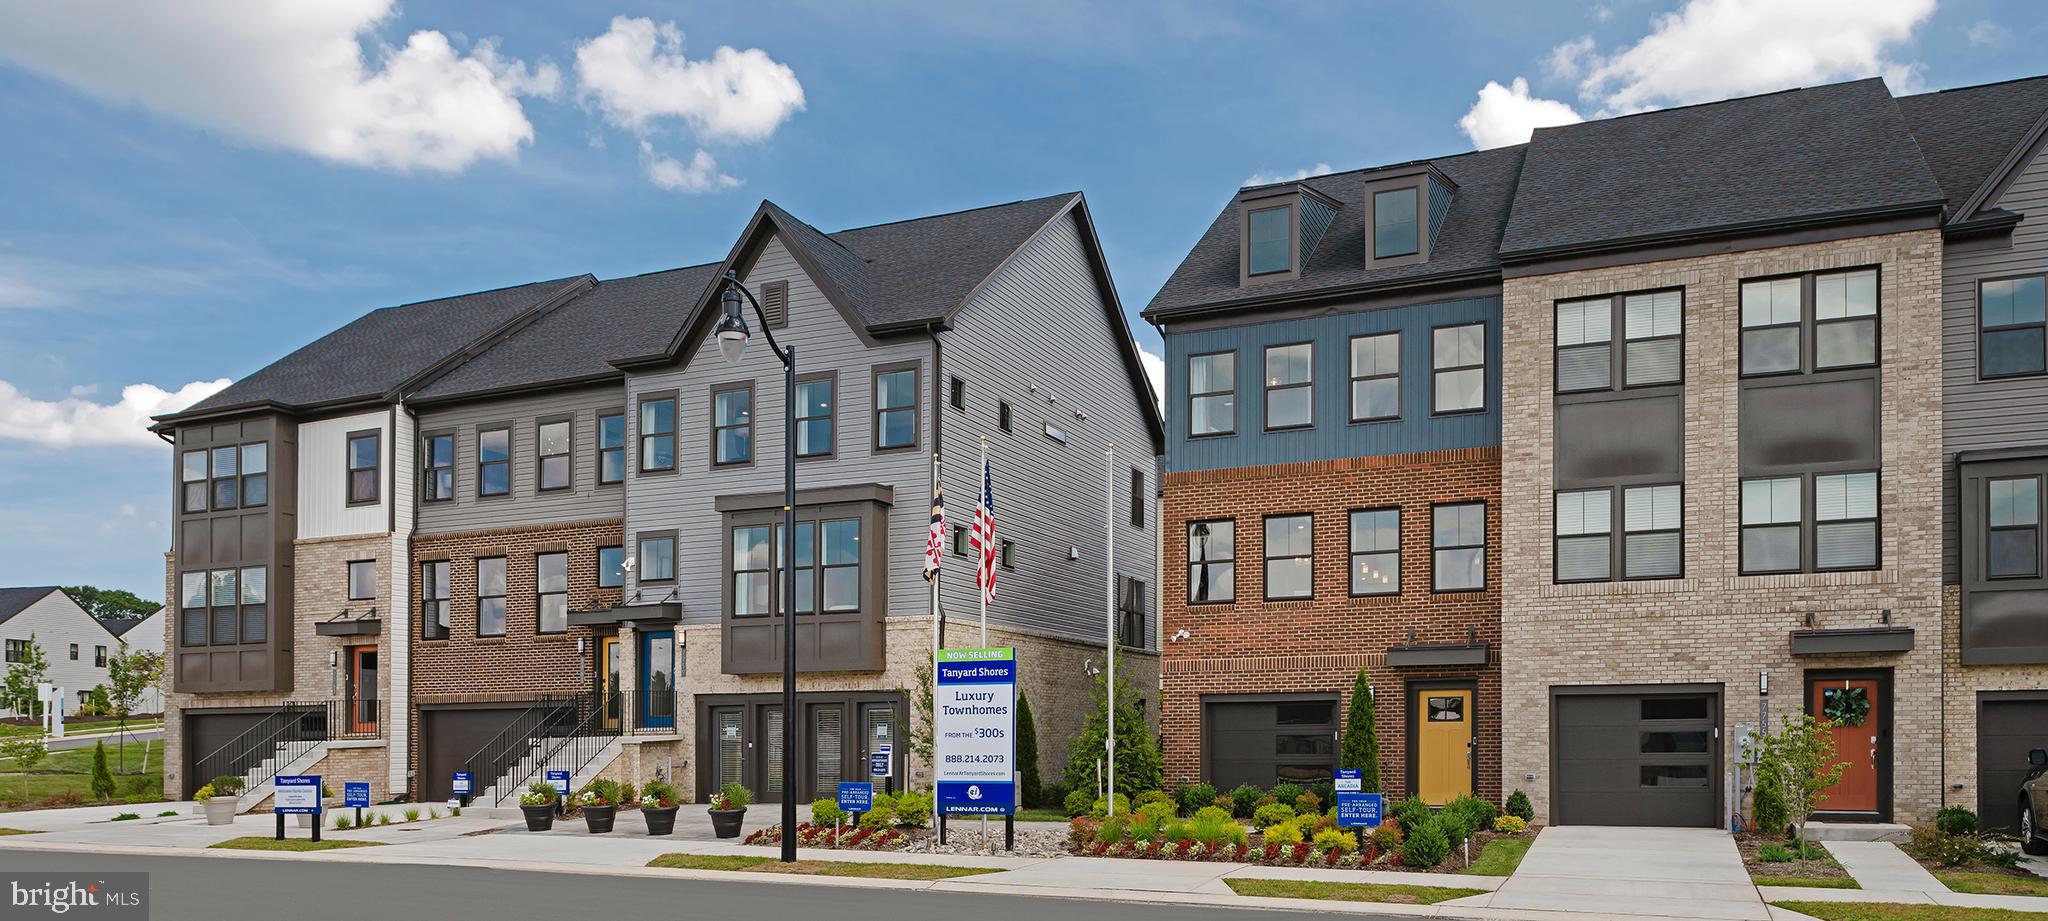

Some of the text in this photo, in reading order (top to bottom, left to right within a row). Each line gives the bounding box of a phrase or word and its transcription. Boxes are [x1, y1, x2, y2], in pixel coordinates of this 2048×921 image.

[947, 650, 1004, 660] NOW SELLING
[941, 667, 1009, 679] Tanyard Shores
[955, 691, 995, 703] Luxury
[942, 705, 1008, 716] Townhomes
[974, 727, 1005, 739] $300s
[945, 754, 1005, 763] 888.214.2073
